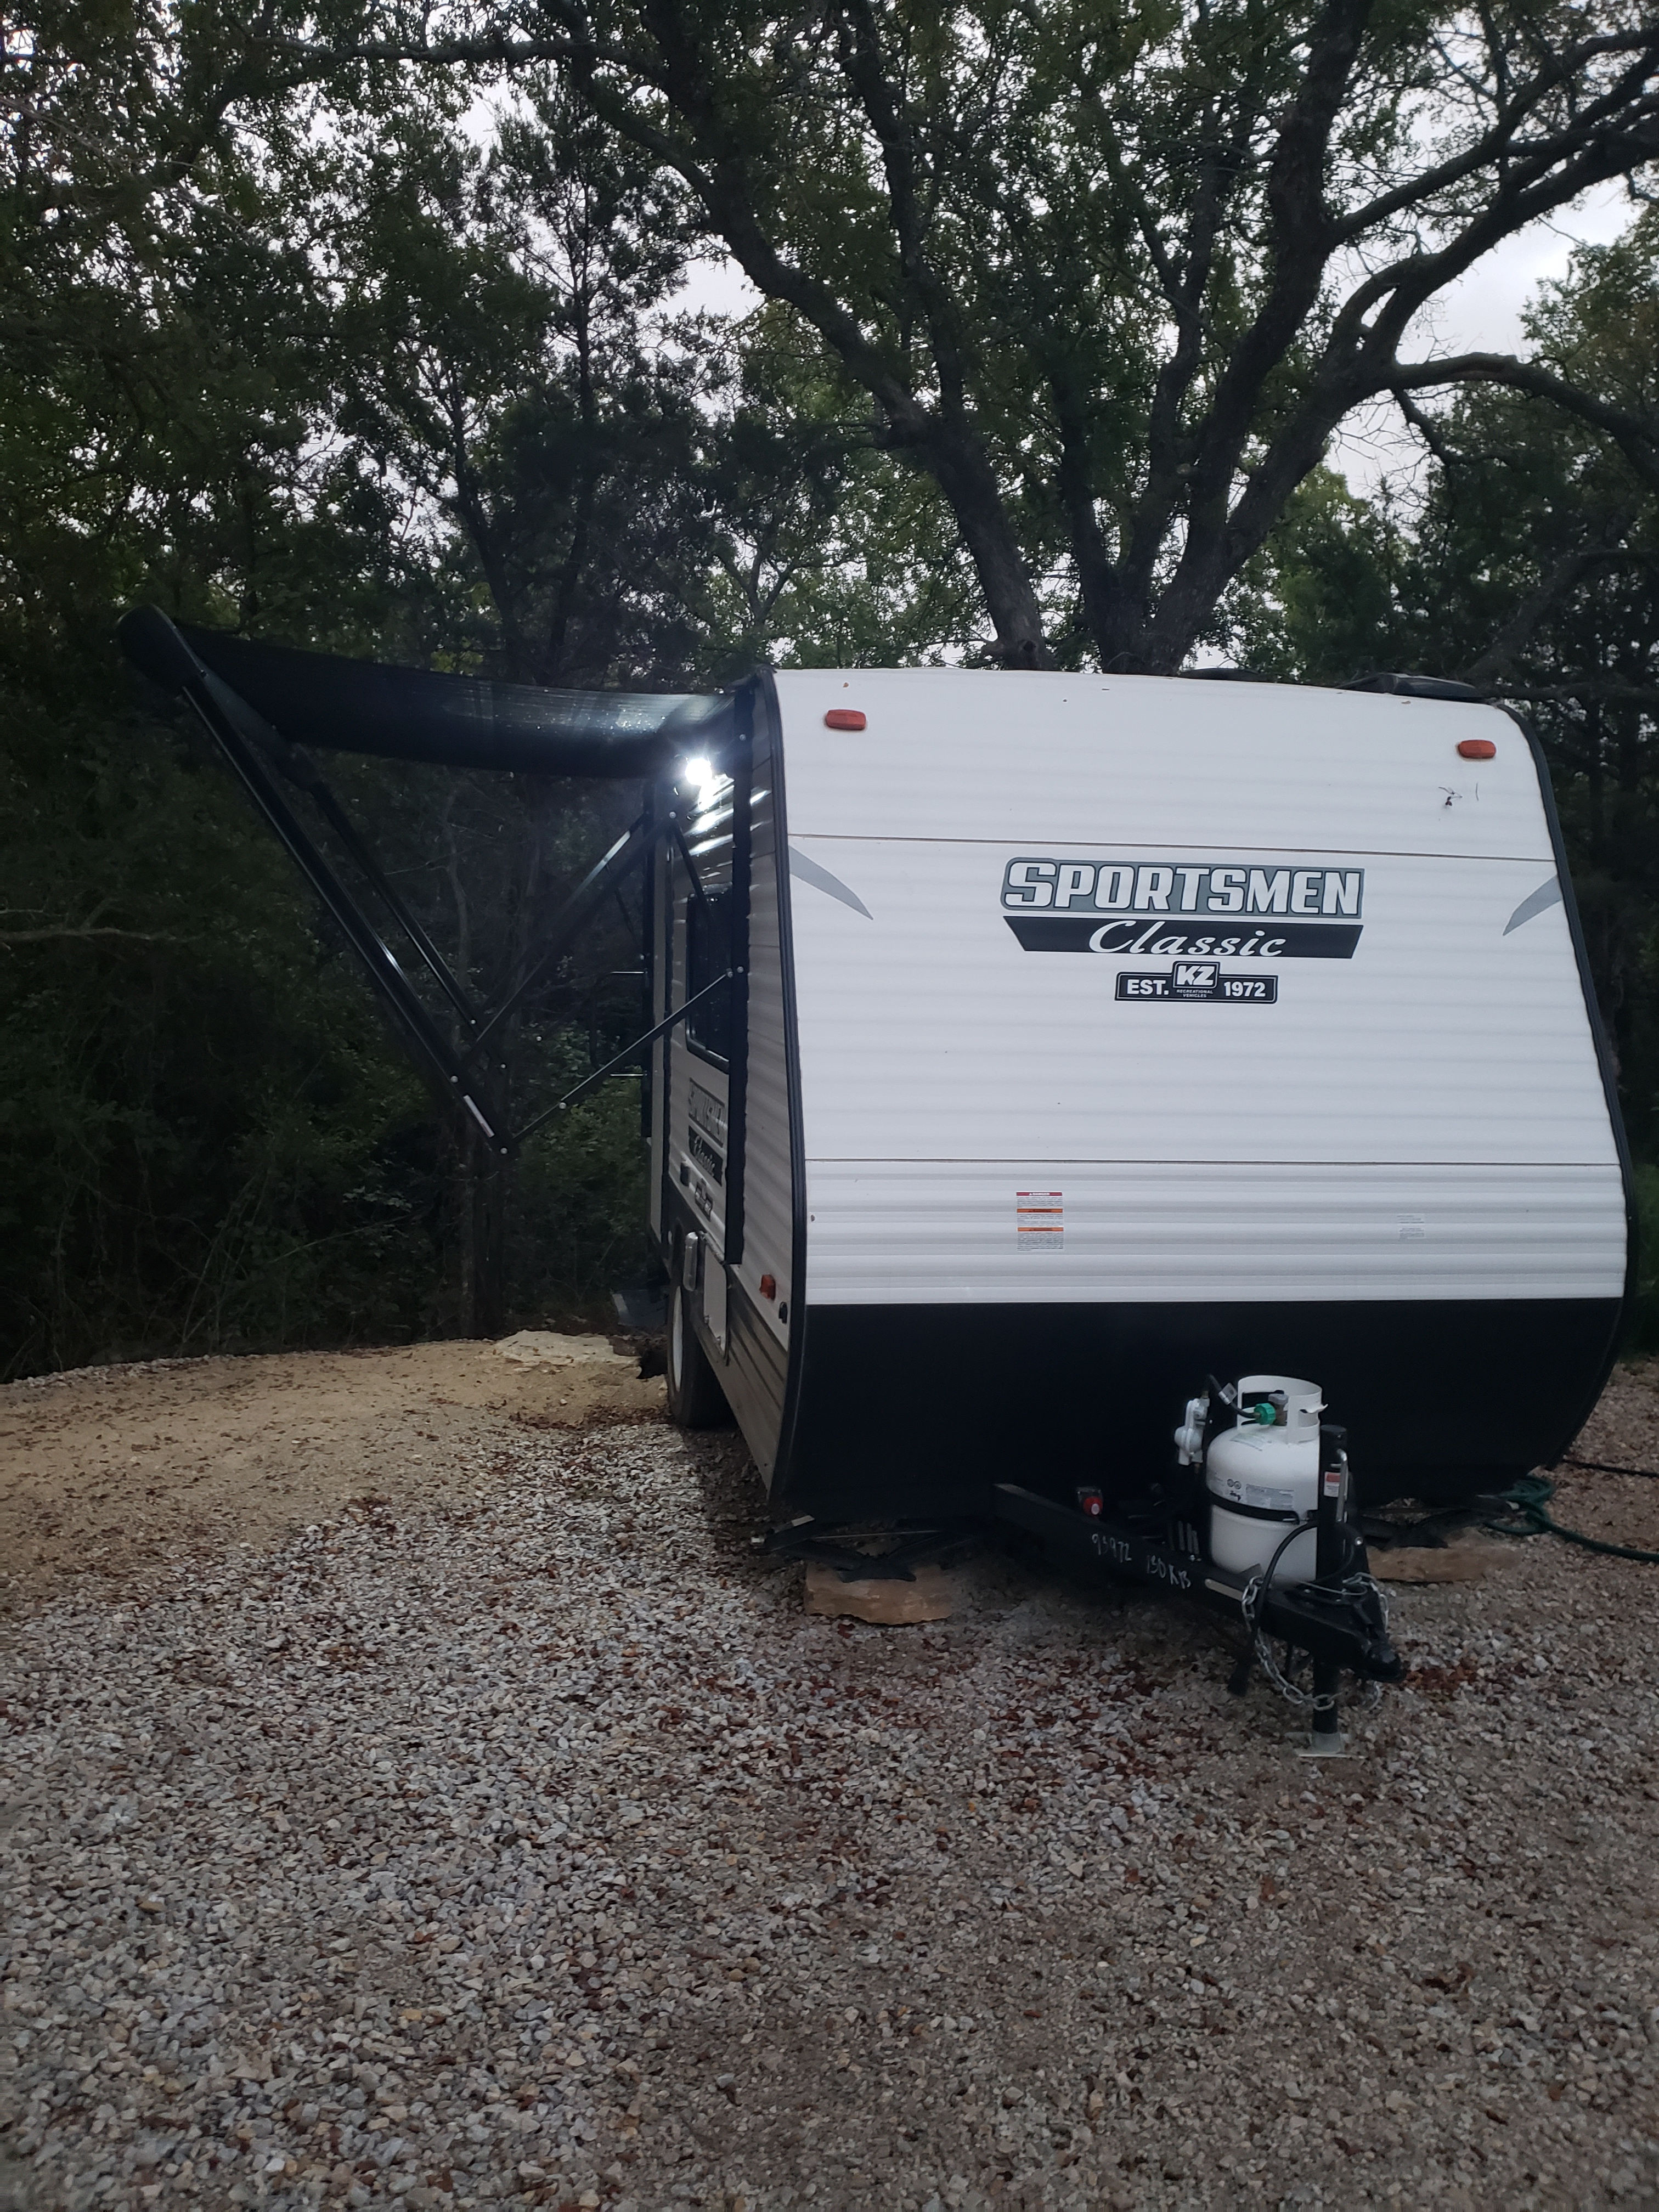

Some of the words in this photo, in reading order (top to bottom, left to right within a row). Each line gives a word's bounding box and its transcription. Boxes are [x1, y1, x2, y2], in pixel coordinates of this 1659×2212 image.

[1003, 860, 1362, 916] SPORTSMEN
[1088, 919, 1286, 957] Classic
[1126, 979, 1169, 995] EST.
[1223, 981, 1266, 997] 1972
[1177, 966, 1216, 986] KZ
